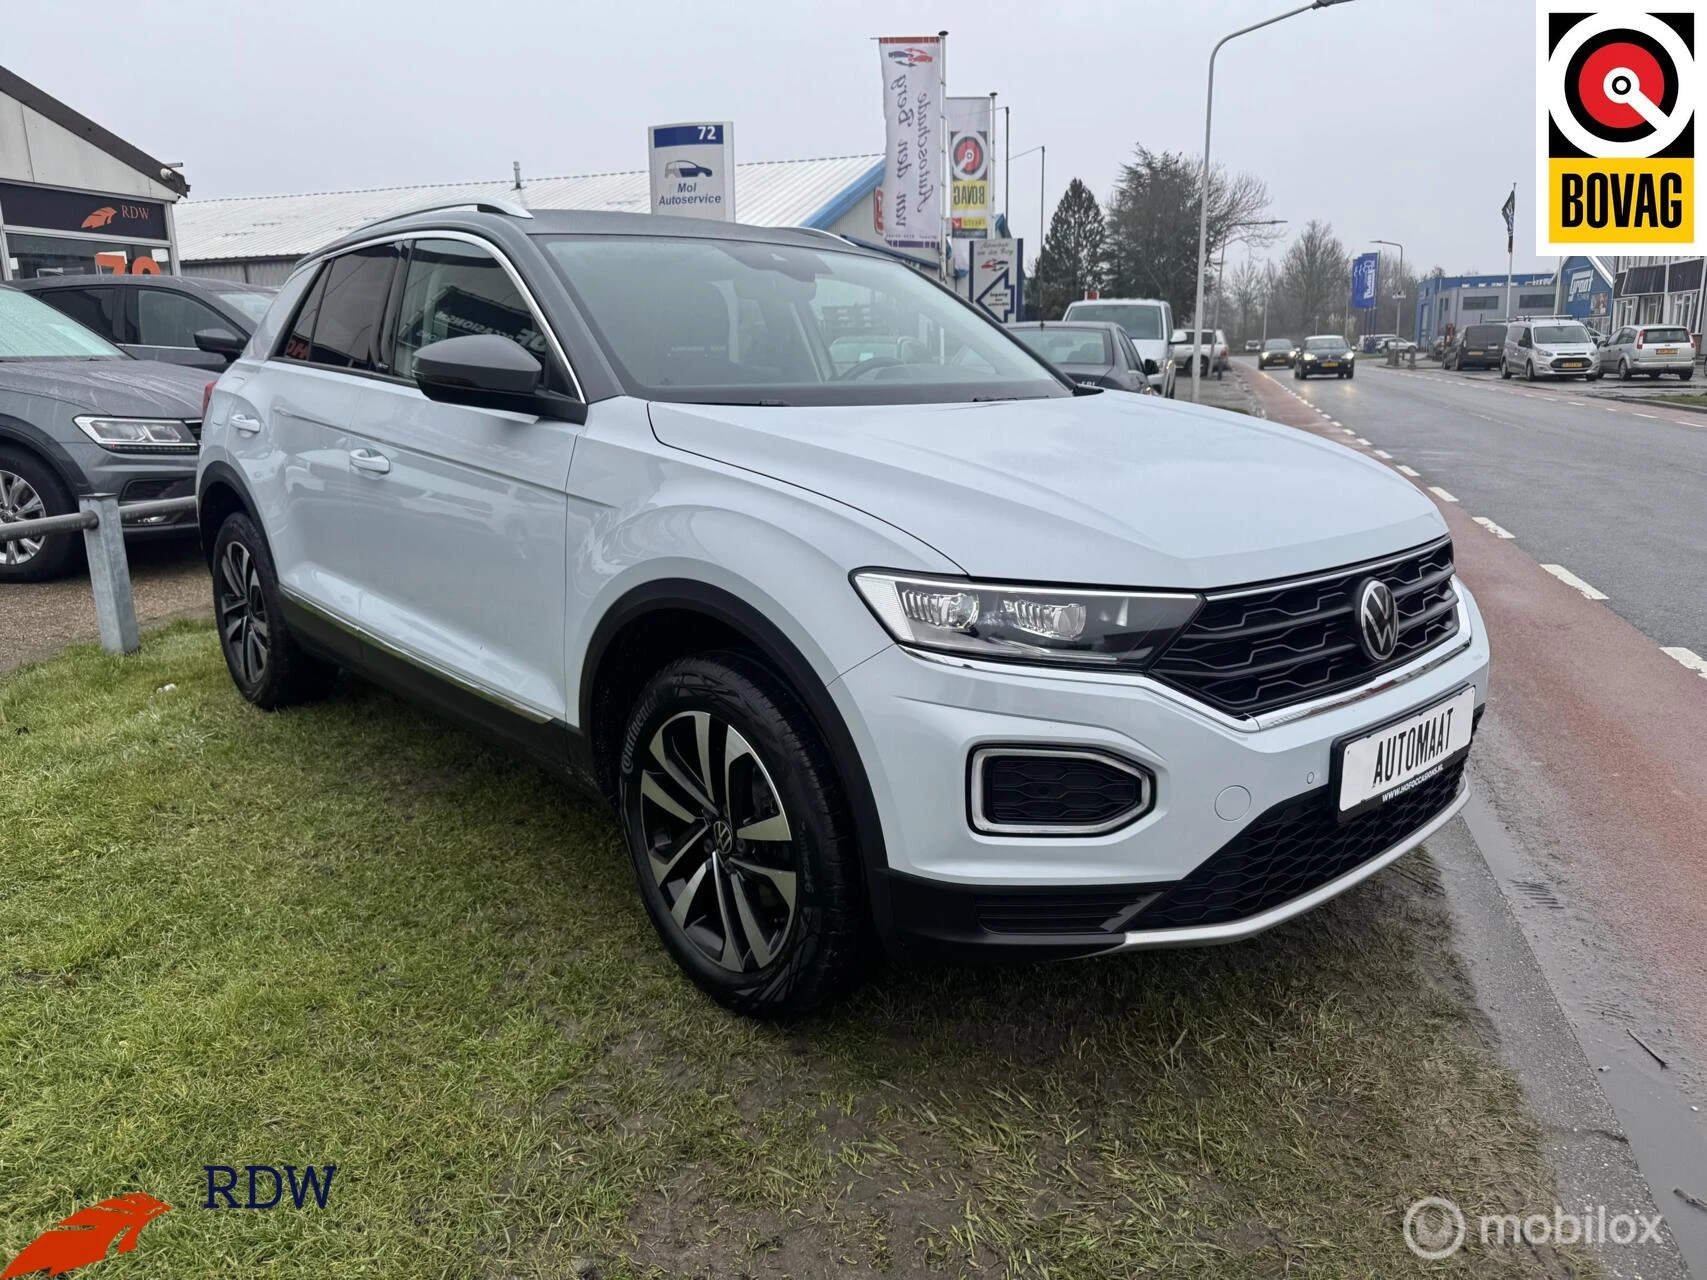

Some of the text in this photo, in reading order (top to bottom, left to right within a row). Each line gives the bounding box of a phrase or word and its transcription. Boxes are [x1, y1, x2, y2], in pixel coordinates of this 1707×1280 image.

[697, 126, 717, 140] 72
[677, 183, 697, 193] Mol
[658, 193, 722, 206] Autoservice
[121, 205, 150, 220] RDW
[1372, 707, 1454, 786] AUTOMAAT
